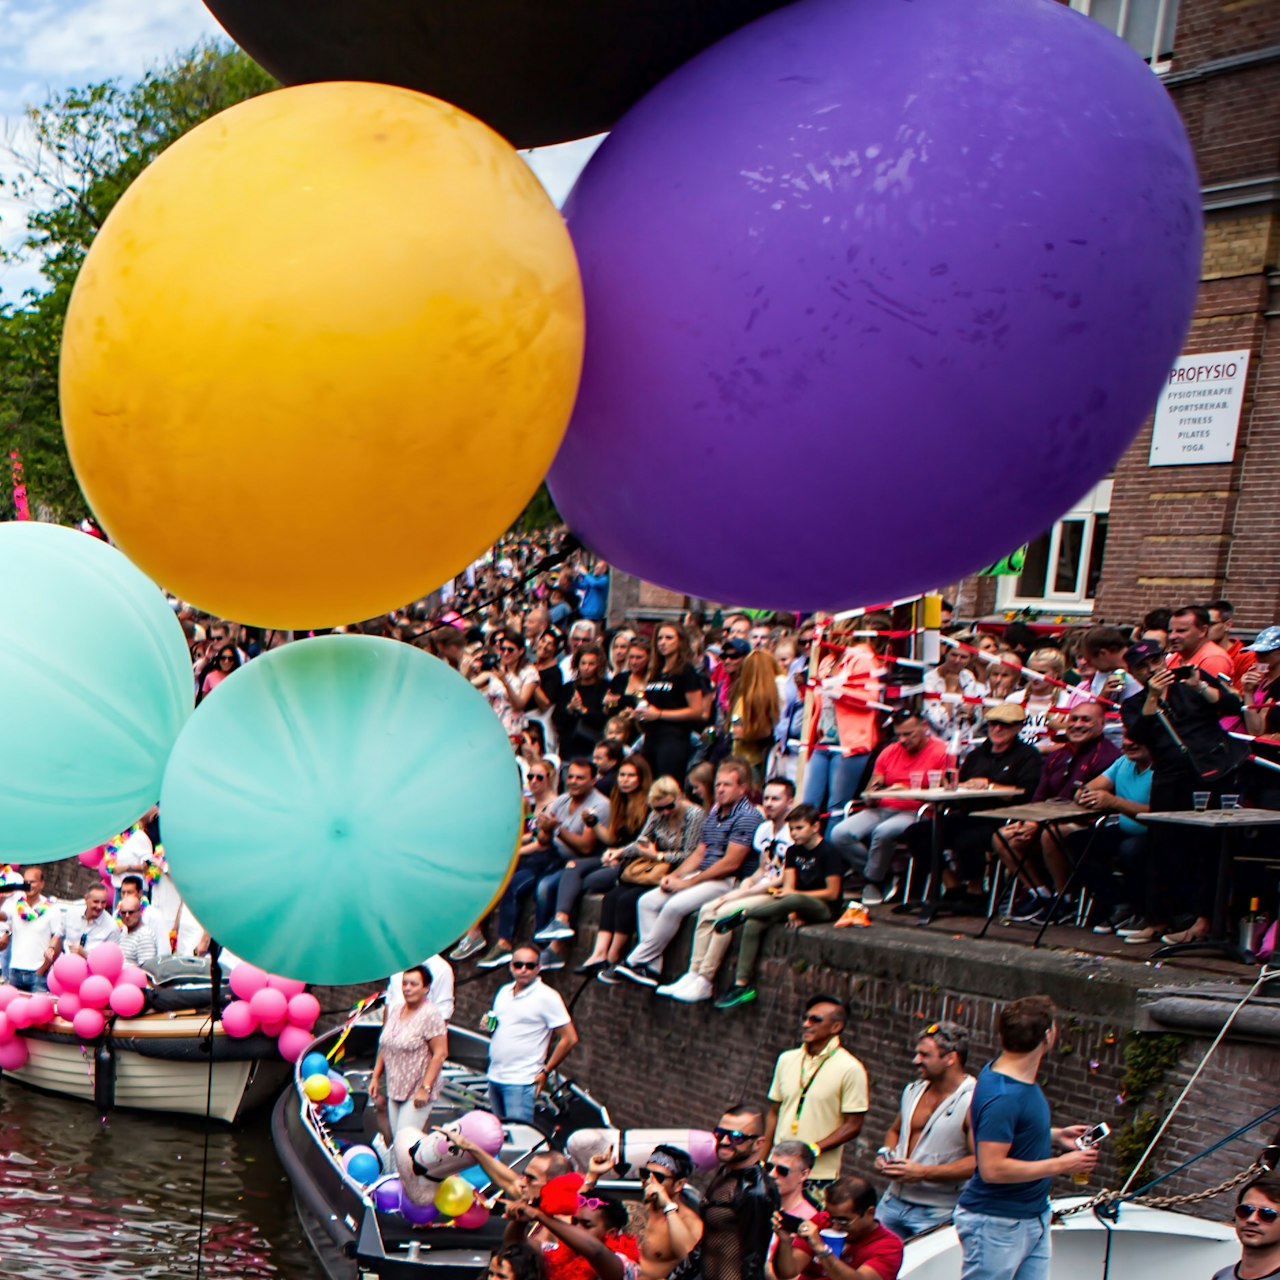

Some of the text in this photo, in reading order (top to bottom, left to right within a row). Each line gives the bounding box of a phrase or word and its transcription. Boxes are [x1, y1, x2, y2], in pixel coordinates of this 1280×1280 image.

[1168, 363, 1237, 385] PROFYSIO
[1168, 387, 1233, 399] FYSIOTHERAPIE
[1168, 401, 1229, 413] SPORTSREHAB.
[1179, 416, 1213, 425] FITNESS
[1177, 430, 1211, 439] PILATES
[1181, 444, 1204, 453] YOGA
